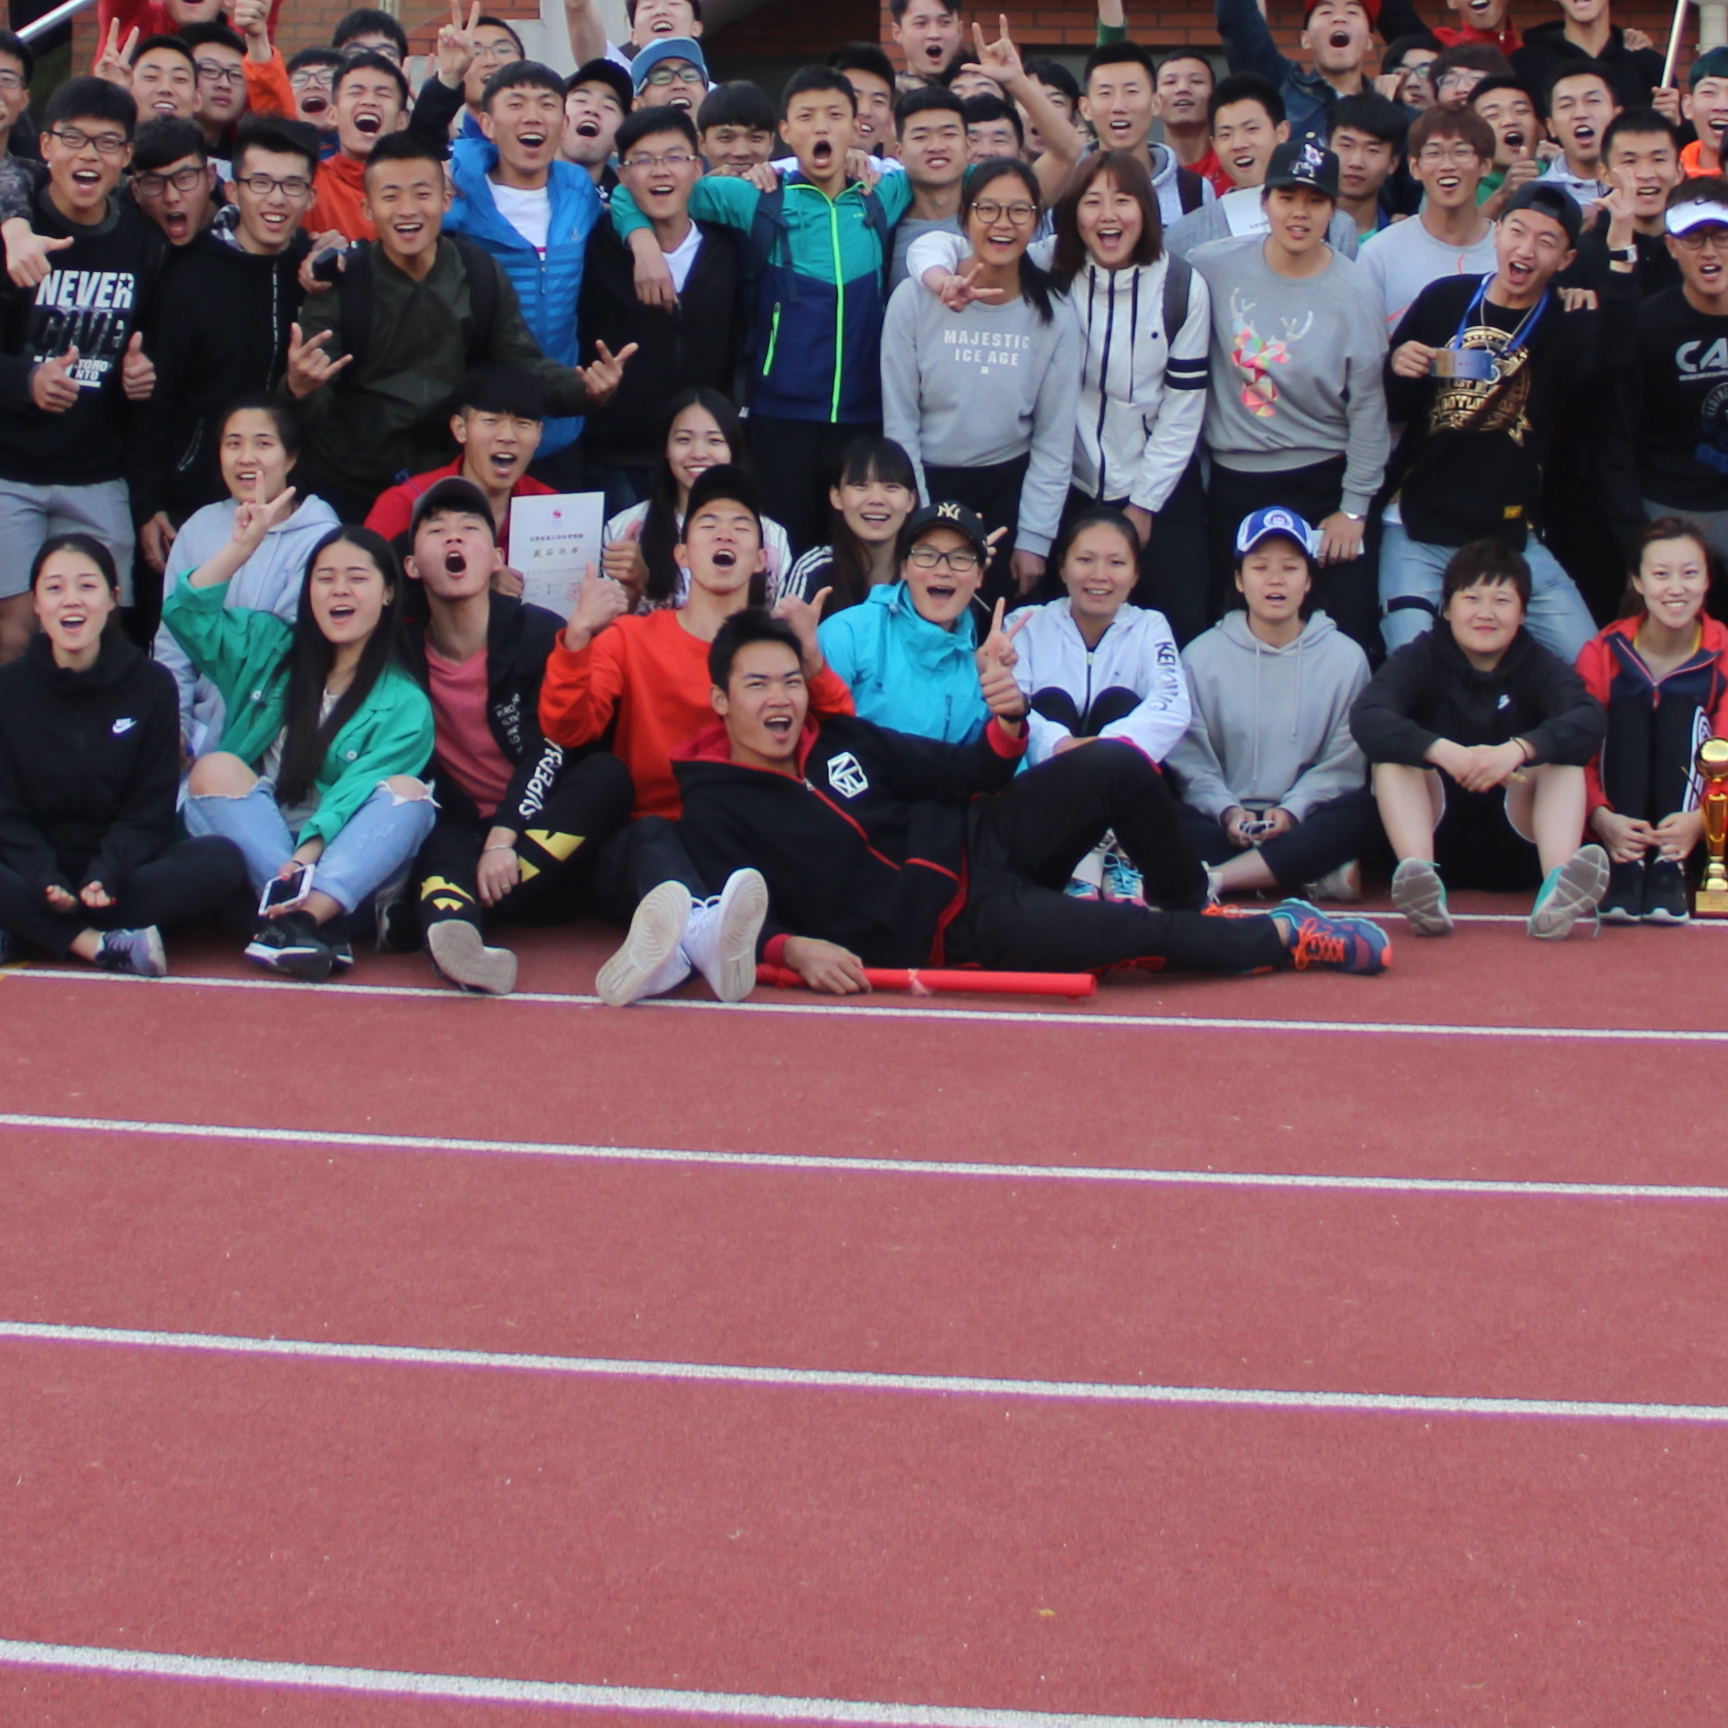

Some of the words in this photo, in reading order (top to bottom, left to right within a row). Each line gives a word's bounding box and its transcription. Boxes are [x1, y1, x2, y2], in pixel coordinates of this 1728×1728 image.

[35, 270, 135, 309] NEVER
[944, 329, 1031, 349] MAJESTIC
[955, 348, 982, 363] ICE
[987, 350, 1020, 366] AGE
